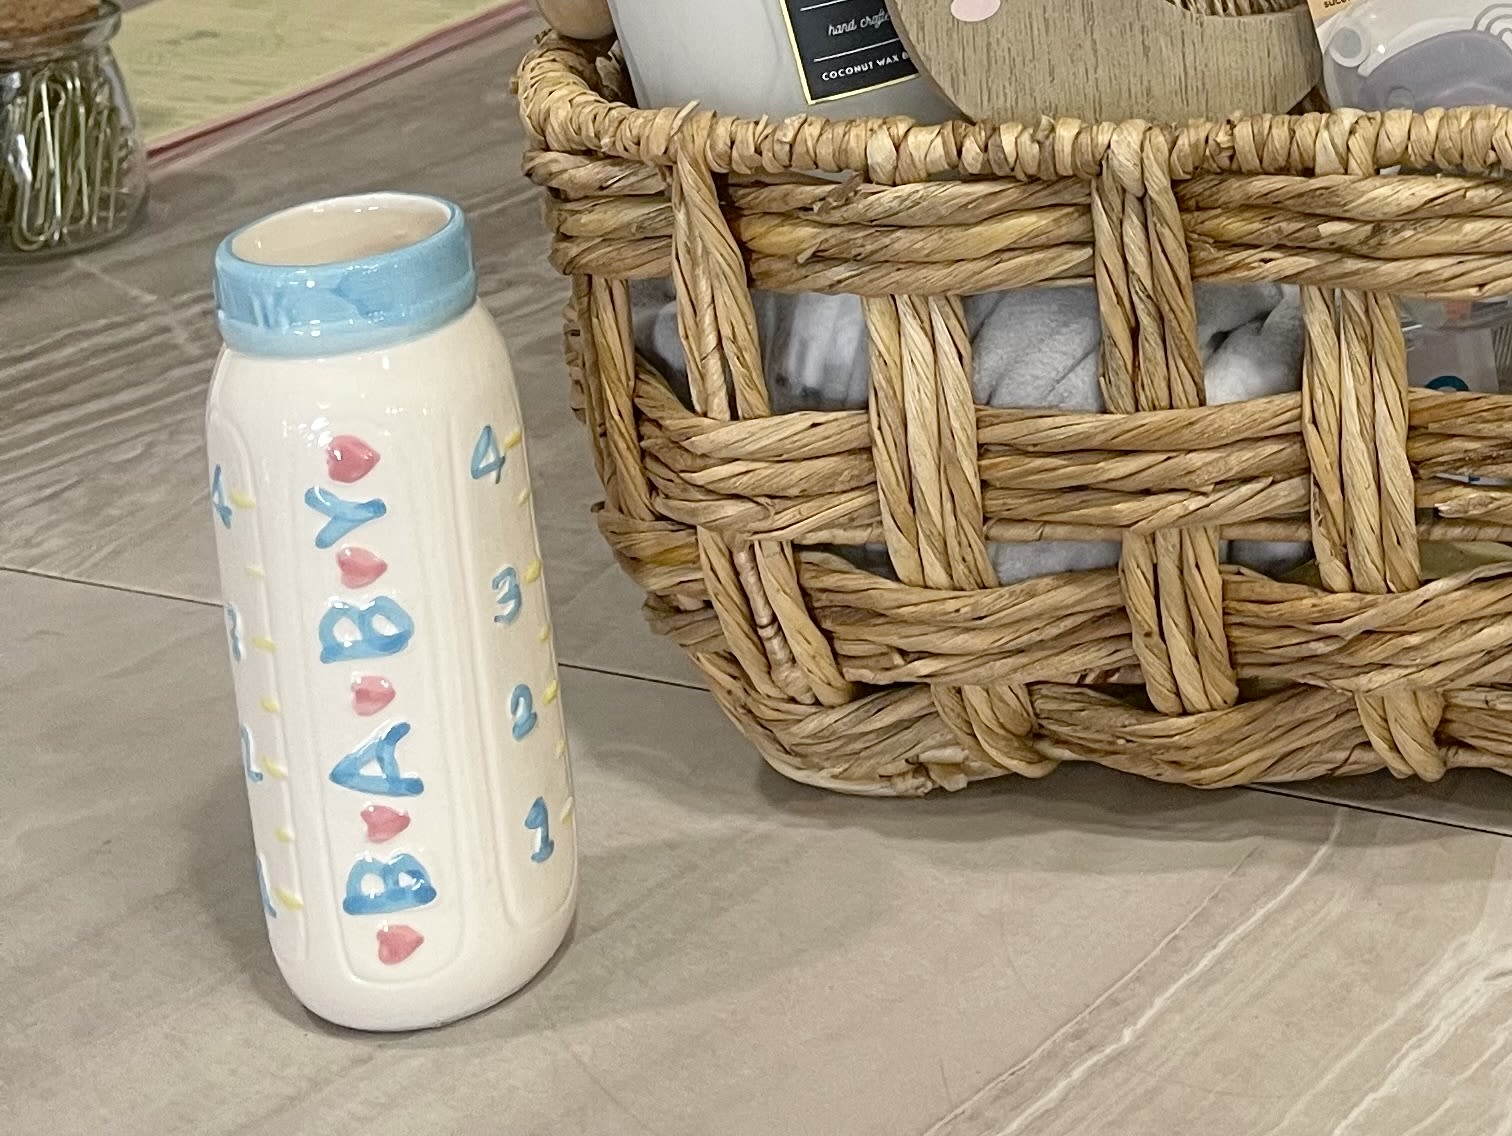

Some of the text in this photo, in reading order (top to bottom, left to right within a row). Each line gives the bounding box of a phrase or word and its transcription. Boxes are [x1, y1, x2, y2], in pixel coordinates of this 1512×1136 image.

[827, 18, 858, 36] hand
[821, 60, 874, 81] COCONUT
[876, 53, 900, 67] WAX
[470, 423, 507, 485] 4
[491, 566, 523, 624] 3
[509, 683, 538, 742] 2
[523, 796, 556, 865] 1
